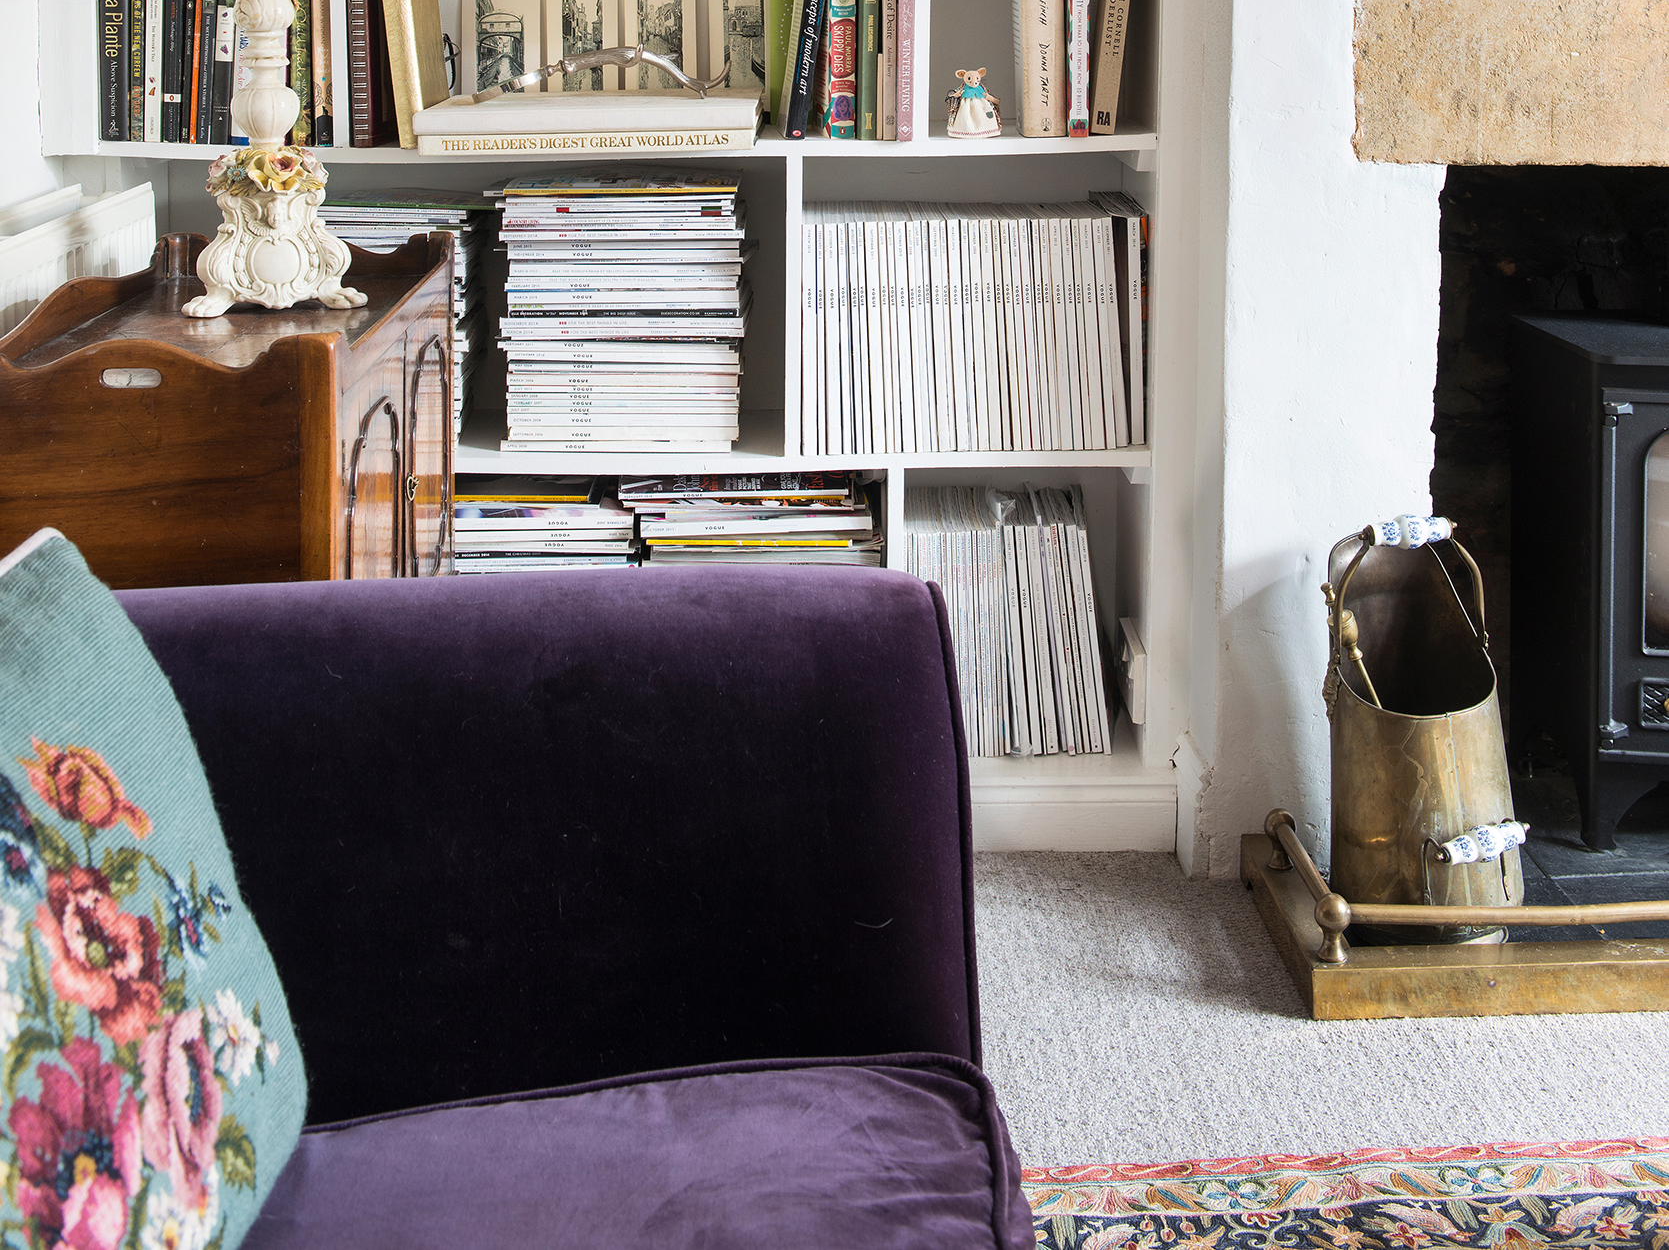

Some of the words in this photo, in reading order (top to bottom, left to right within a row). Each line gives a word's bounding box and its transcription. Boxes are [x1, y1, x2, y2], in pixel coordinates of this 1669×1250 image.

[133, 10, 142, 20] OF
[885, 2, 896, 12] of
[104, 12, 124, 58] Plante
[134, 20, 142, 33] THE
[803, 26, 818, 42] of
[833, 25, 844, 53] SKIPPY
[885, 12, 896, 40] Desire
[1112, 7, 1124, 57] CORNELL
[133, 34, 142, 50] NEW
[110, 60, 119, 81] Above
[133, 50, 142, 78] CURFEW
[800, 38, 815, 77] modern
[833, 53, 844, 74] DIES
[902, 38, 911, 77] WINTER
[1038, 42, 1050, 72] DONNA
[108, 81, 119, 118] Suspicion
[798, 77, 808, 97] art
[902, 78, 911, 113] LIVING
[1039, 75, 1050, 107] TARTT
[1096, 110, 1111, 126] RA
[441, 140, 470, 152] THE
[472, 137, 537, 151] READER'S
[539, 137, 588, 150] DIGEST
[589, 136, 635, 149] GREAT
[635, 134, 684, 148] WORLD
[685, 133, 730, 146] ATLAS
